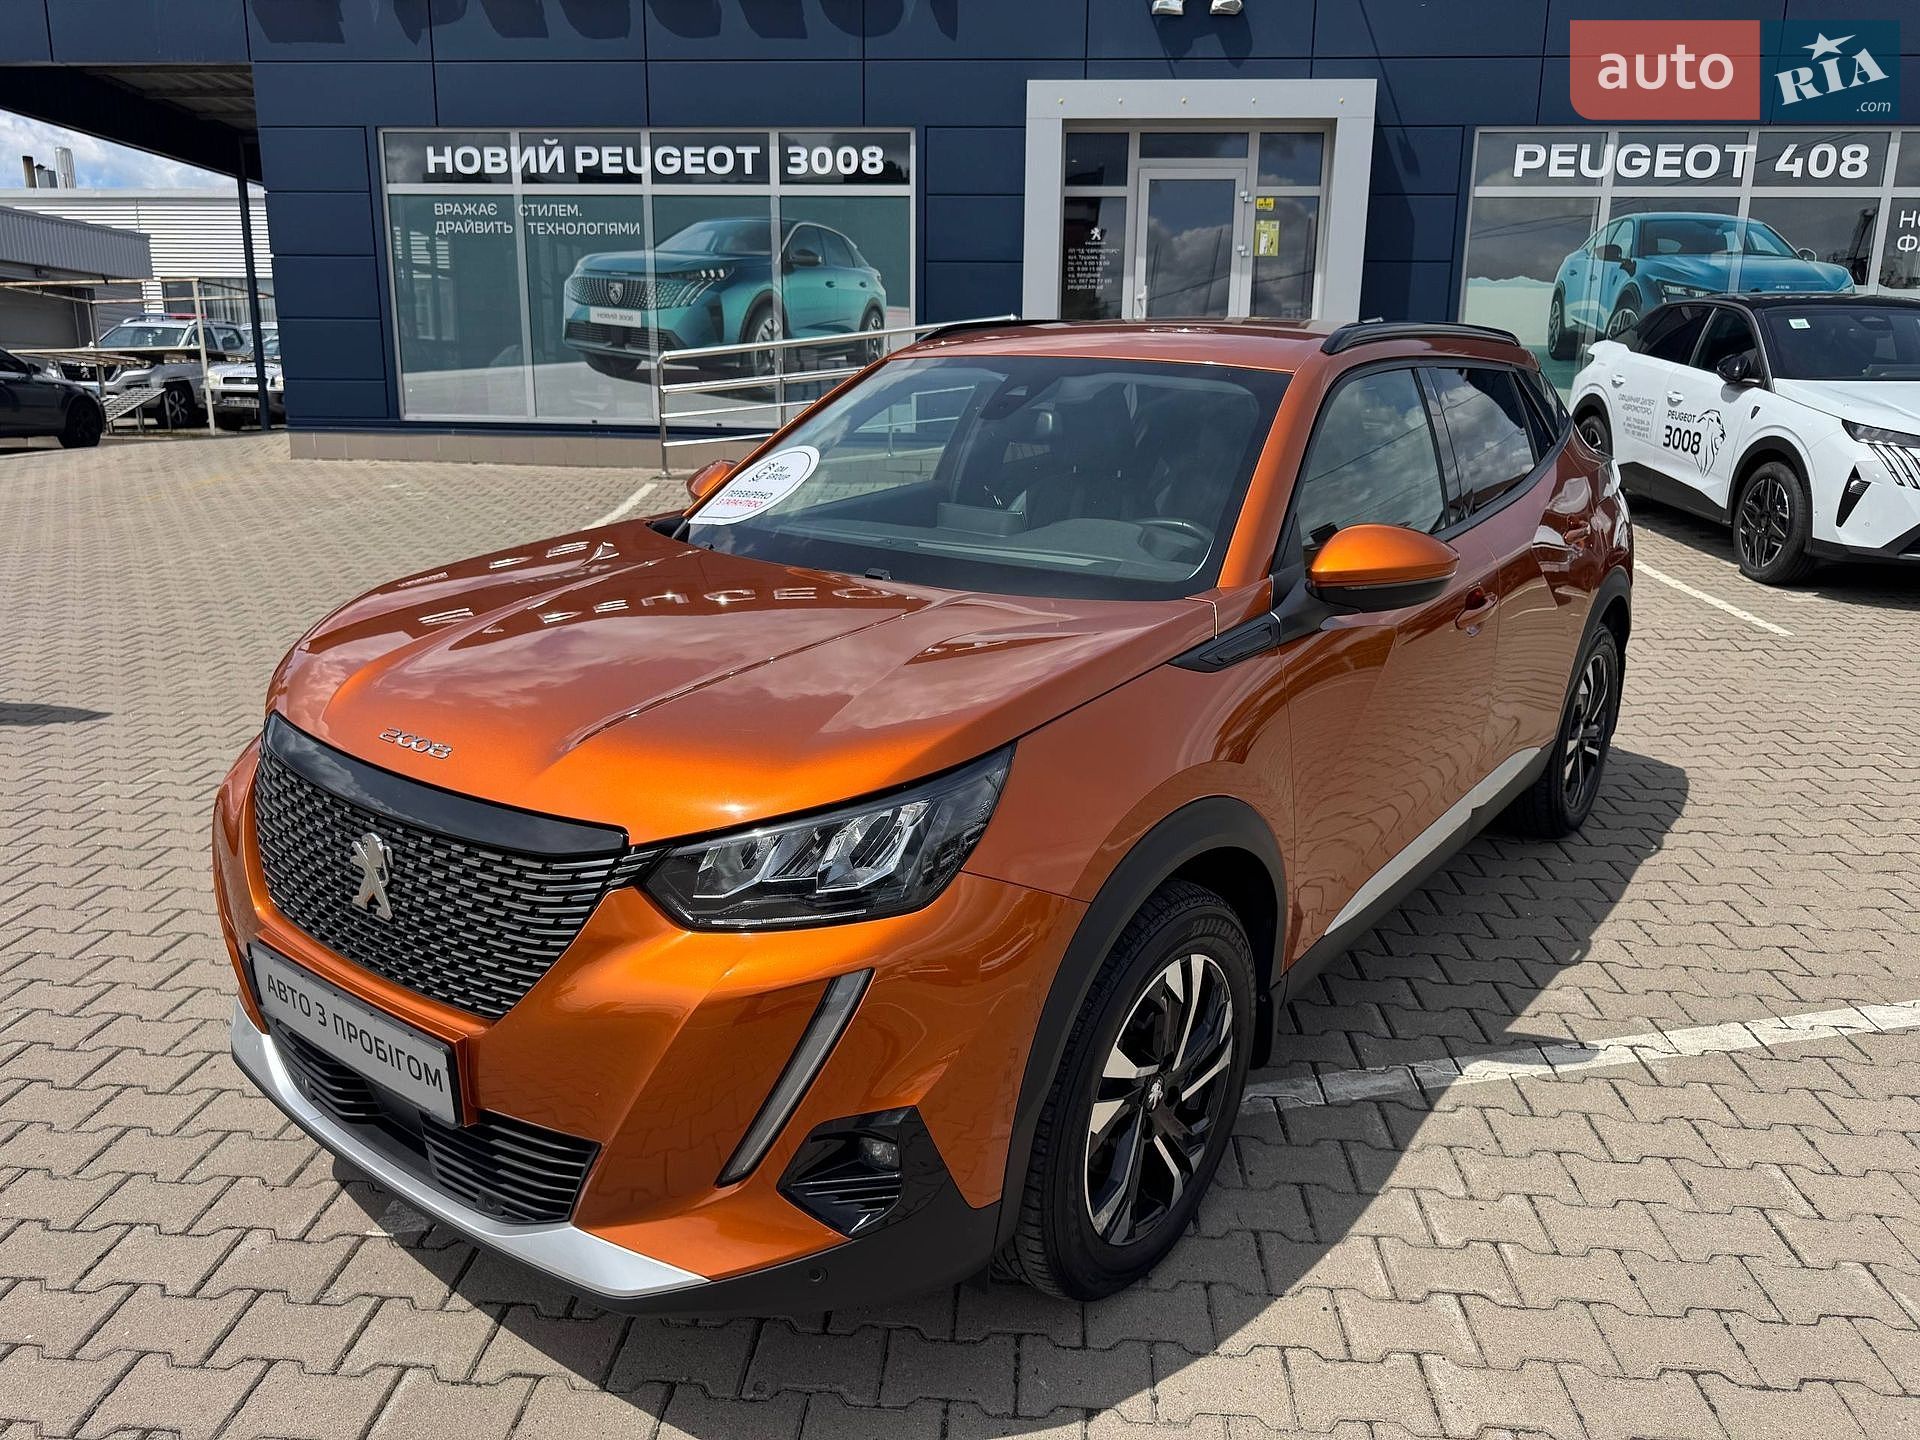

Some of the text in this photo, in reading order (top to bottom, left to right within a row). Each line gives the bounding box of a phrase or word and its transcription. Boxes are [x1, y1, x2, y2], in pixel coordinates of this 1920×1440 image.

[426, 139, 885, 175] НОВИЙ PEUGEOT 3008
[1513, 143, 1869, 178] PEUGEOT 408
[433, 202, 583, 218] ВРАЖАЄ СТИЛЕМ.
[1899, 210, 1920, 229] Н
[434, 218, 641, 236] ДРАЙВИТЬ ТЕХНОЛОГІЯМИ
[1896, 234, 1920, 253] Ф
[1668, 409, 1696, 423] PEUGEOT
[1663, 425, 1702, 454] 3008
[377, 727, 455, 760] 2008
[266, 974, 312, 1020] АВТО
[333, 1012, 443, 1093] ПРОБІГОМ
